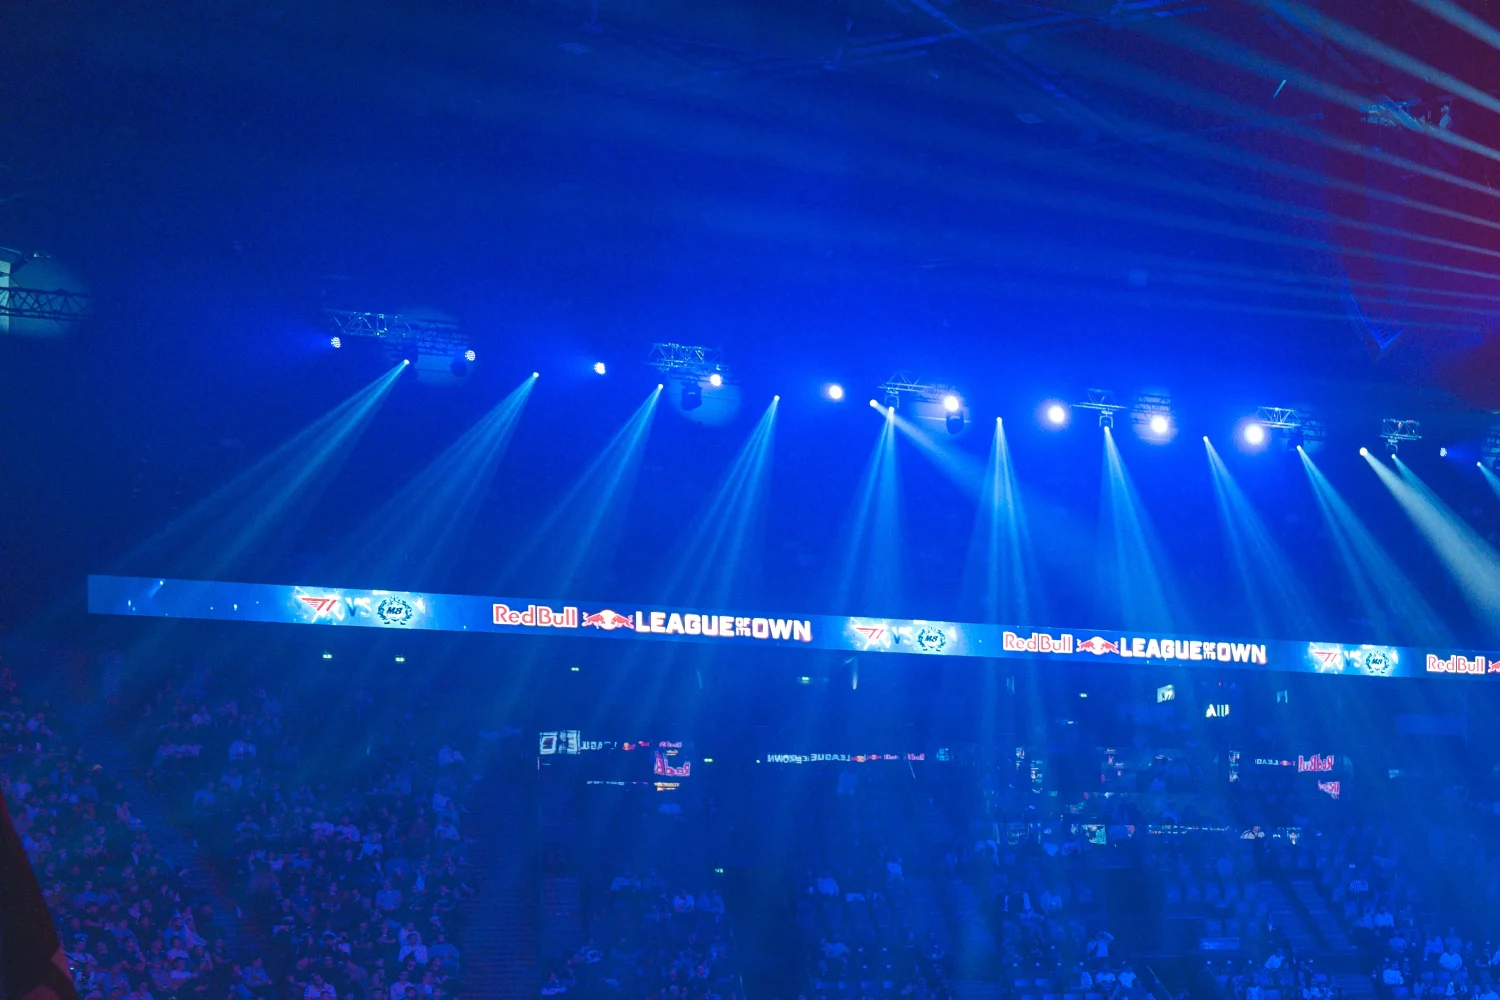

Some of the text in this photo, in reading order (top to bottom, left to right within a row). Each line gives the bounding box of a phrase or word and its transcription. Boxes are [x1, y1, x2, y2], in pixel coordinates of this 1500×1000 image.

[493, 603, 536, 626] Red
[537, 606, 578, 628] Bull
[635, 610, 736, 638] LEAGUE
[752, 617, 813, 642] OWN
[1003, 631, 1038, 652] Red
[1038, 633, 1073, 654] Bull
[1119, 636, 1202, 661] LEAGUE
[1217, 642, 1267, 665] OWN
[1426, 653, 1456, 672] Red
[1456, 655, 1486, 675] Bull
